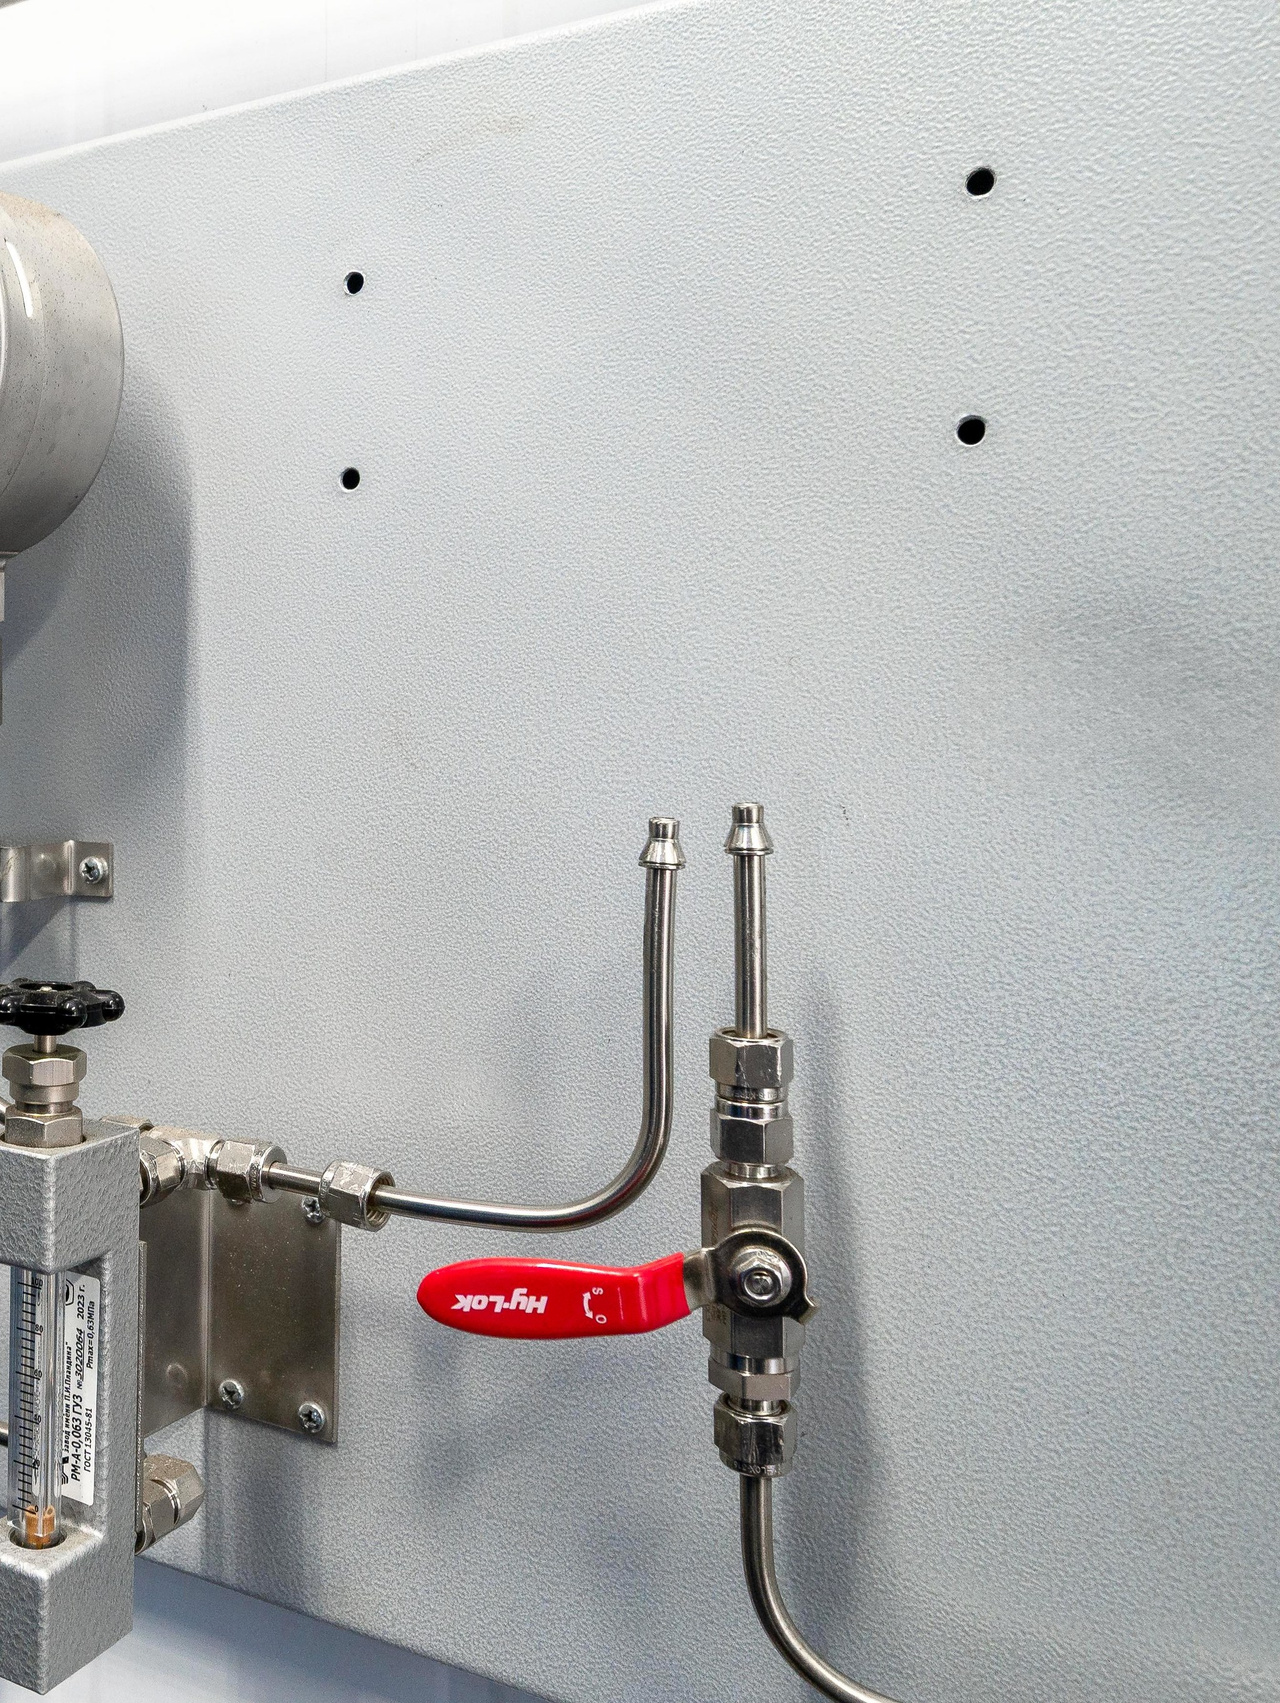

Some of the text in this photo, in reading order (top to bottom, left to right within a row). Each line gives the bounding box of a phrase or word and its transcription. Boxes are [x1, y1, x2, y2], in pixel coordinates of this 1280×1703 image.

[77, 1294, 85, 1320] 2023
[84, 1408, 93, 1473] ГОСТ 13045-81
